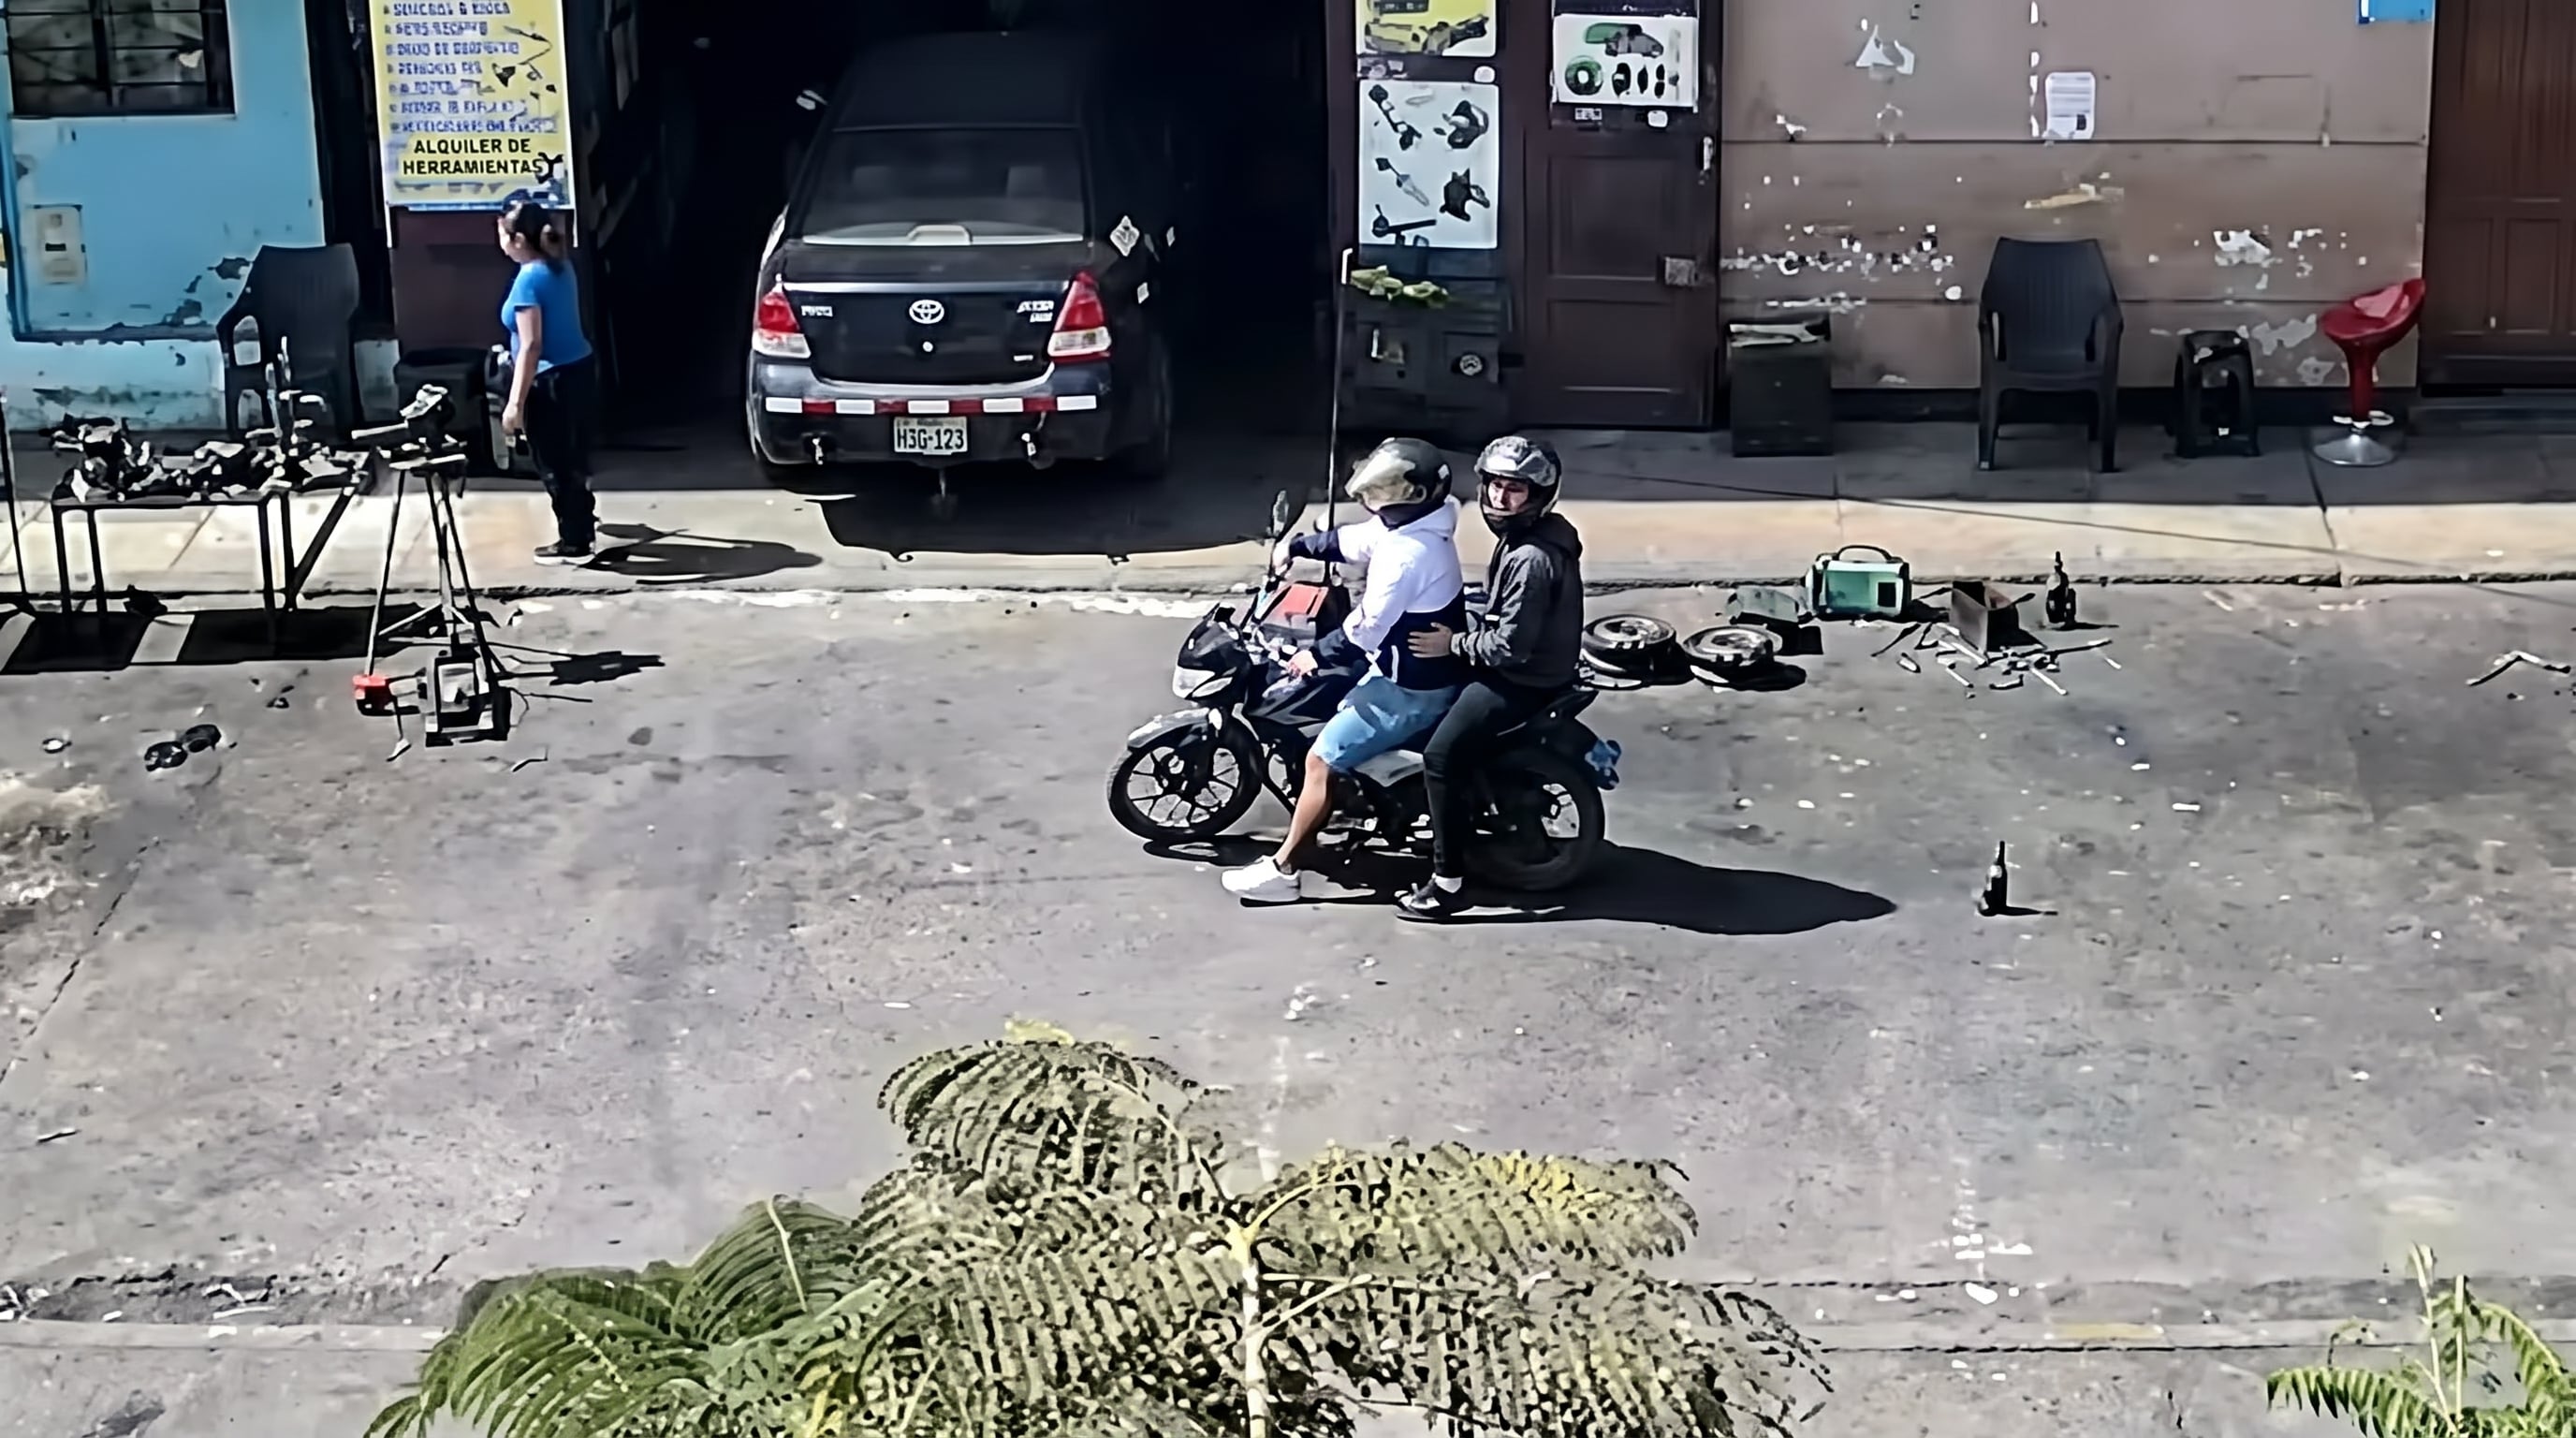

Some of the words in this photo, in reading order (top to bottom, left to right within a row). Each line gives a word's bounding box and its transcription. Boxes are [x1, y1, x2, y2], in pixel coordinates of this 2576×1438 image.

[414, 139, 502, 154] ALQUILER
[508, 139, 531, 153] DE
[403, 159, 543, 174] HERRAMIENTAS
